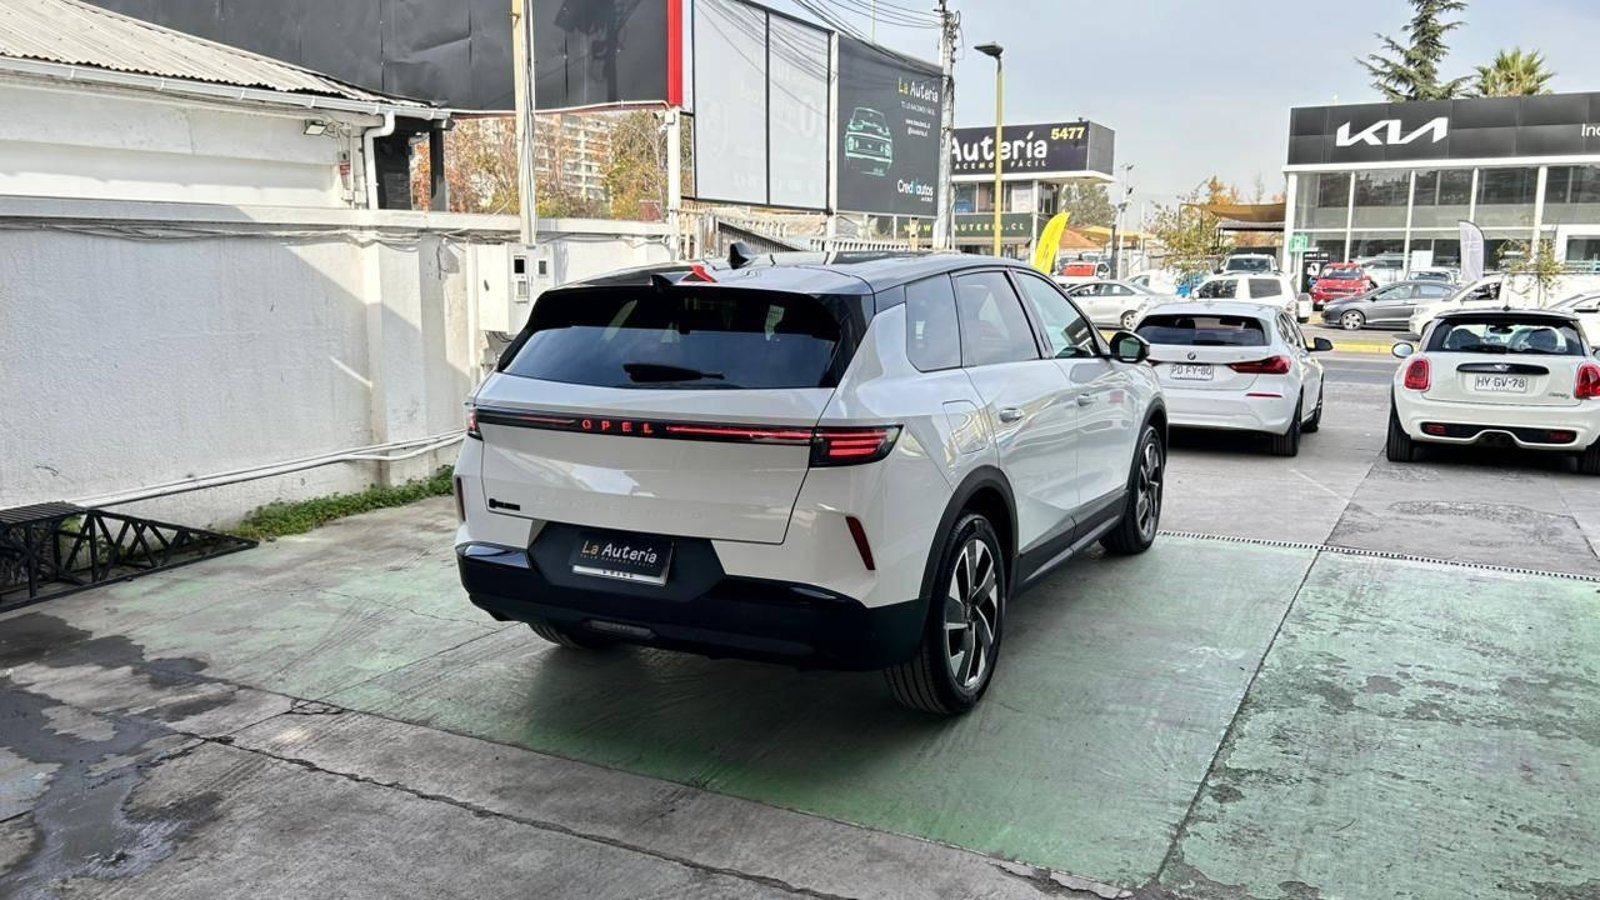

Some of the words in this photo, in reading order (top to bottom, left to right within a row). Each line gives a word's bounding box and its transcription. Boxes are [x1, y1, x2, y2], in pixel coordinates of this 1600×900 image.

[899, 77, 909, 95] La
[1051, 127, 1085, 140] 5477
[1335, 116, 1449, 147] KIA
[582, 419, 654, 434] OPEL
[581, 540, 600, 555] La
[601, 542, 657, 564] Autería
